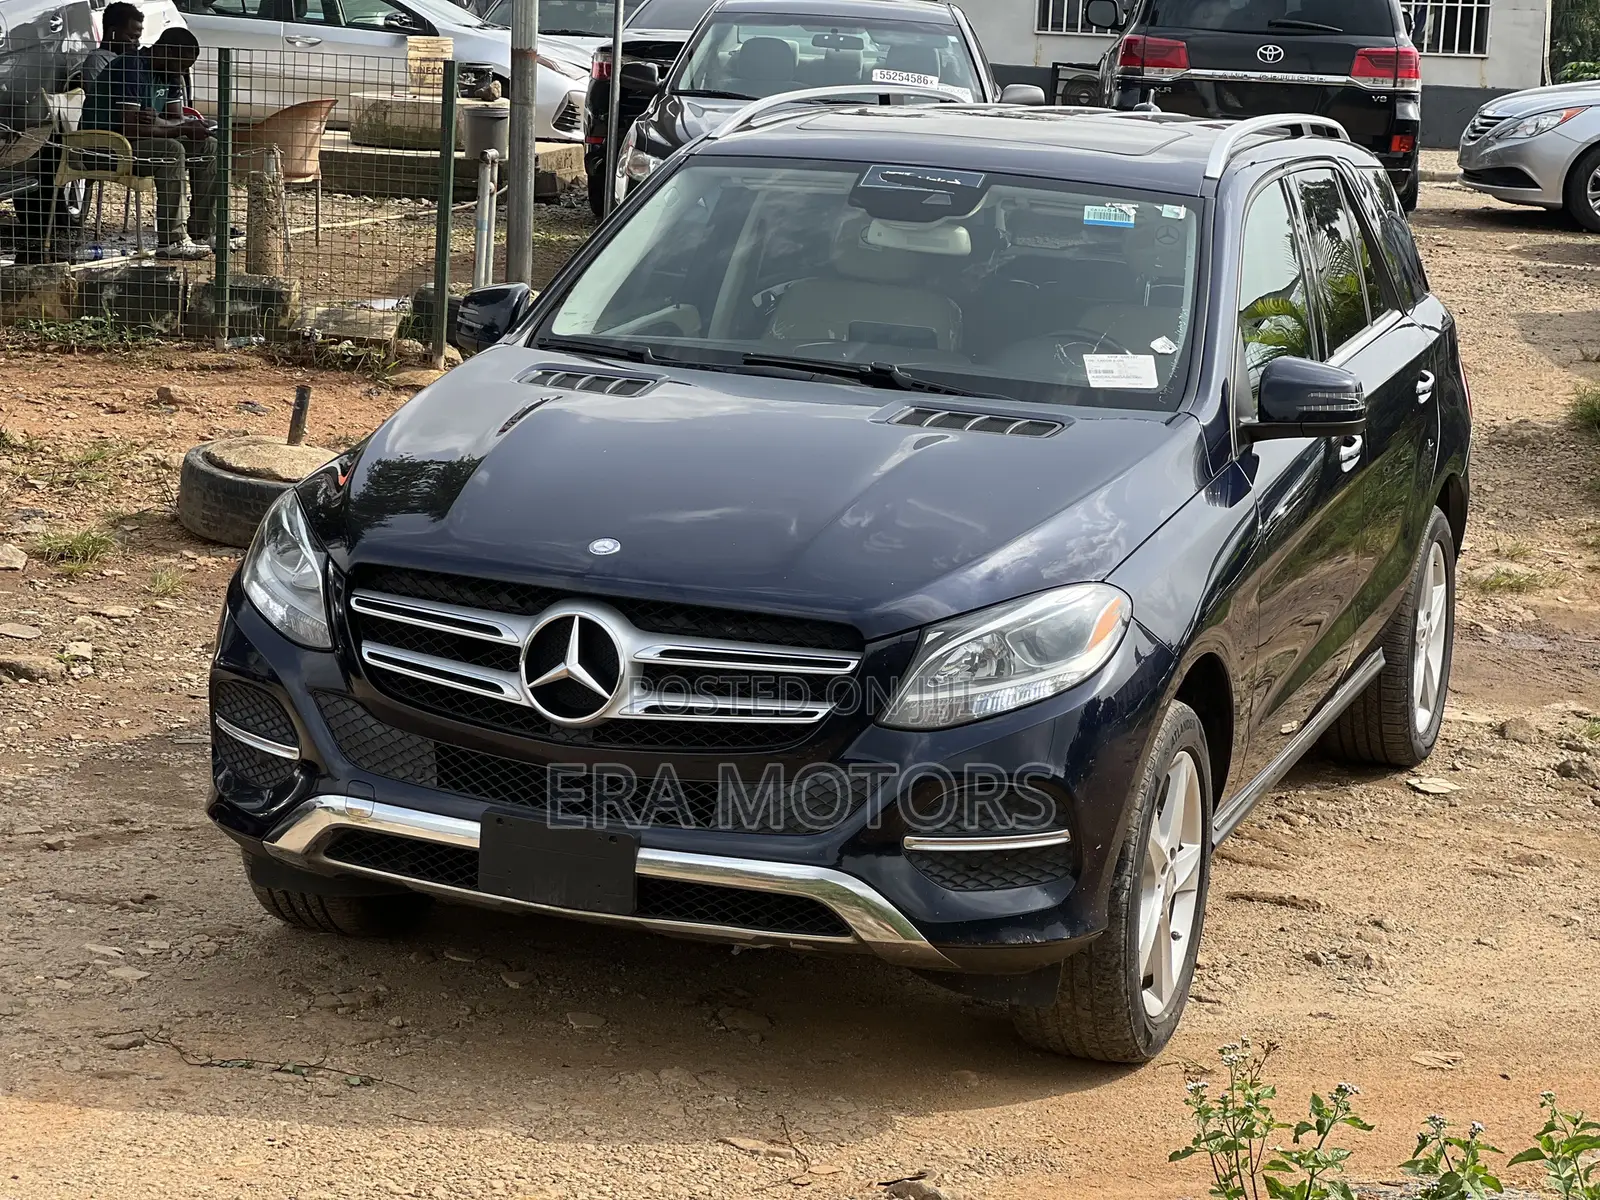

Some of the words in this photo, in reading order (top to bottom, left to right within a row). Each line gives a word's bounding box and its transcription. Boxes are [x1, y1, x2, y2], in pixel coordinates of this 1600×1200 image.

[879, 70, 928, 85] 55254586
[1211, 71, 1249, 80] LAND
[1259, 73, 1327, 83] CRUISER
[1371, 95, 1387, 103] V8
